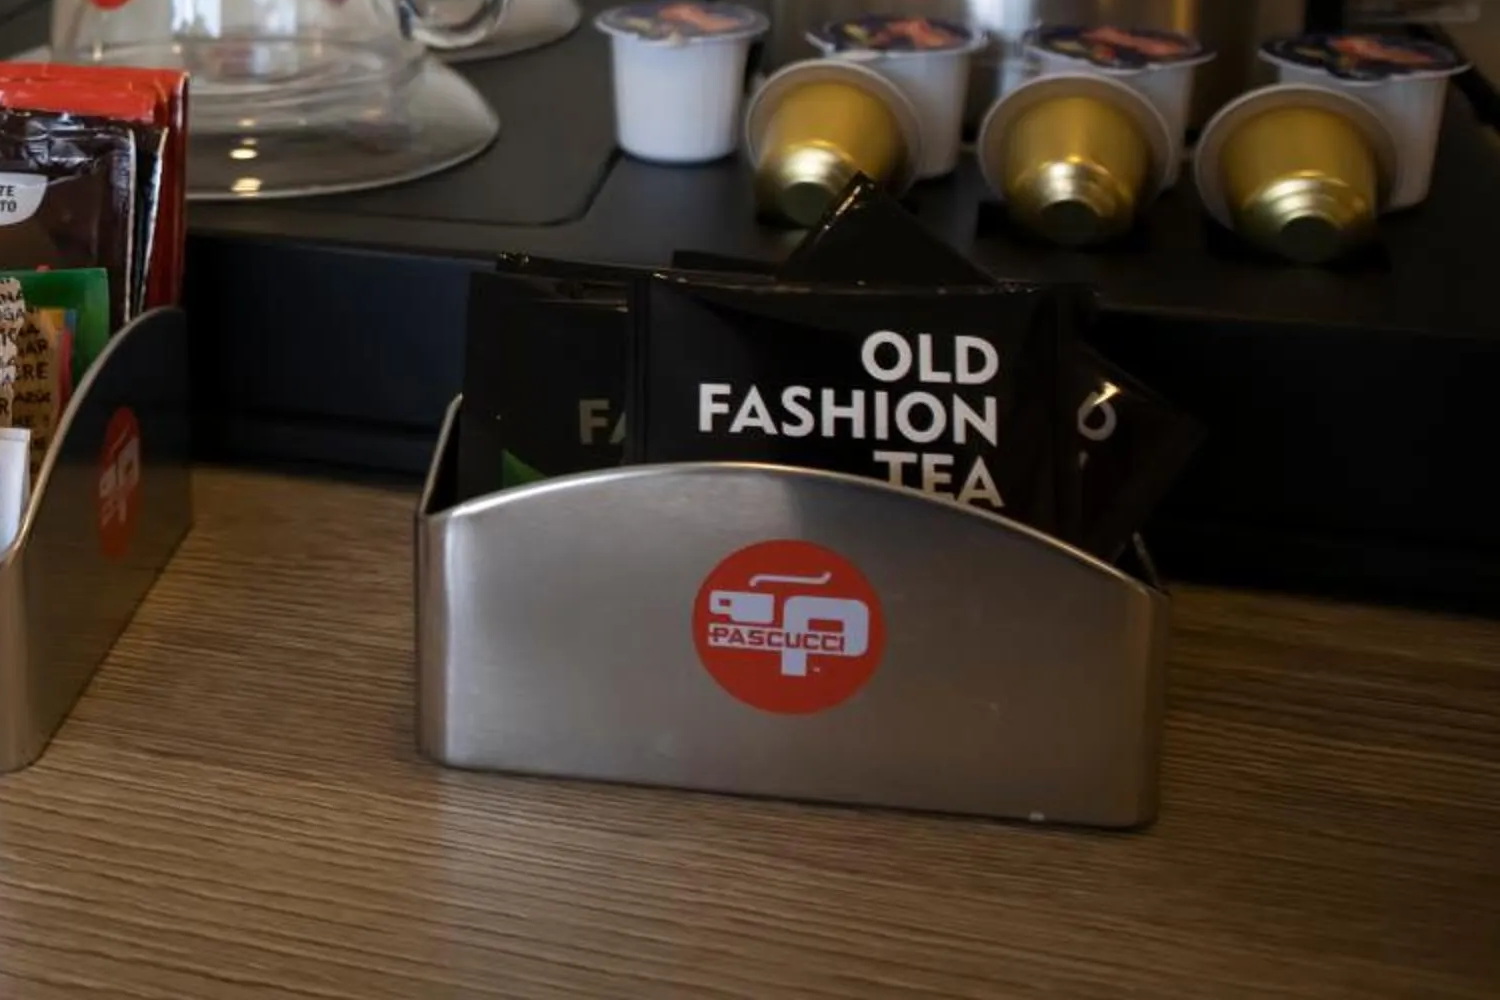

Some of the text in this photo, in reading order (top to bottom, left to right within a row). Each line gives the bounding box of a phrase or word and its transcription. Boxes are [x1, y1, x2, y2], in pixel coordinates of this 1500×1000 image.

[861, 330, 999, 385] OLD
[699, 383, 998, 447] FASHION
[873, 450, 1004, 508] TEA
[713, 626, 845, 652] PASCUCCI
